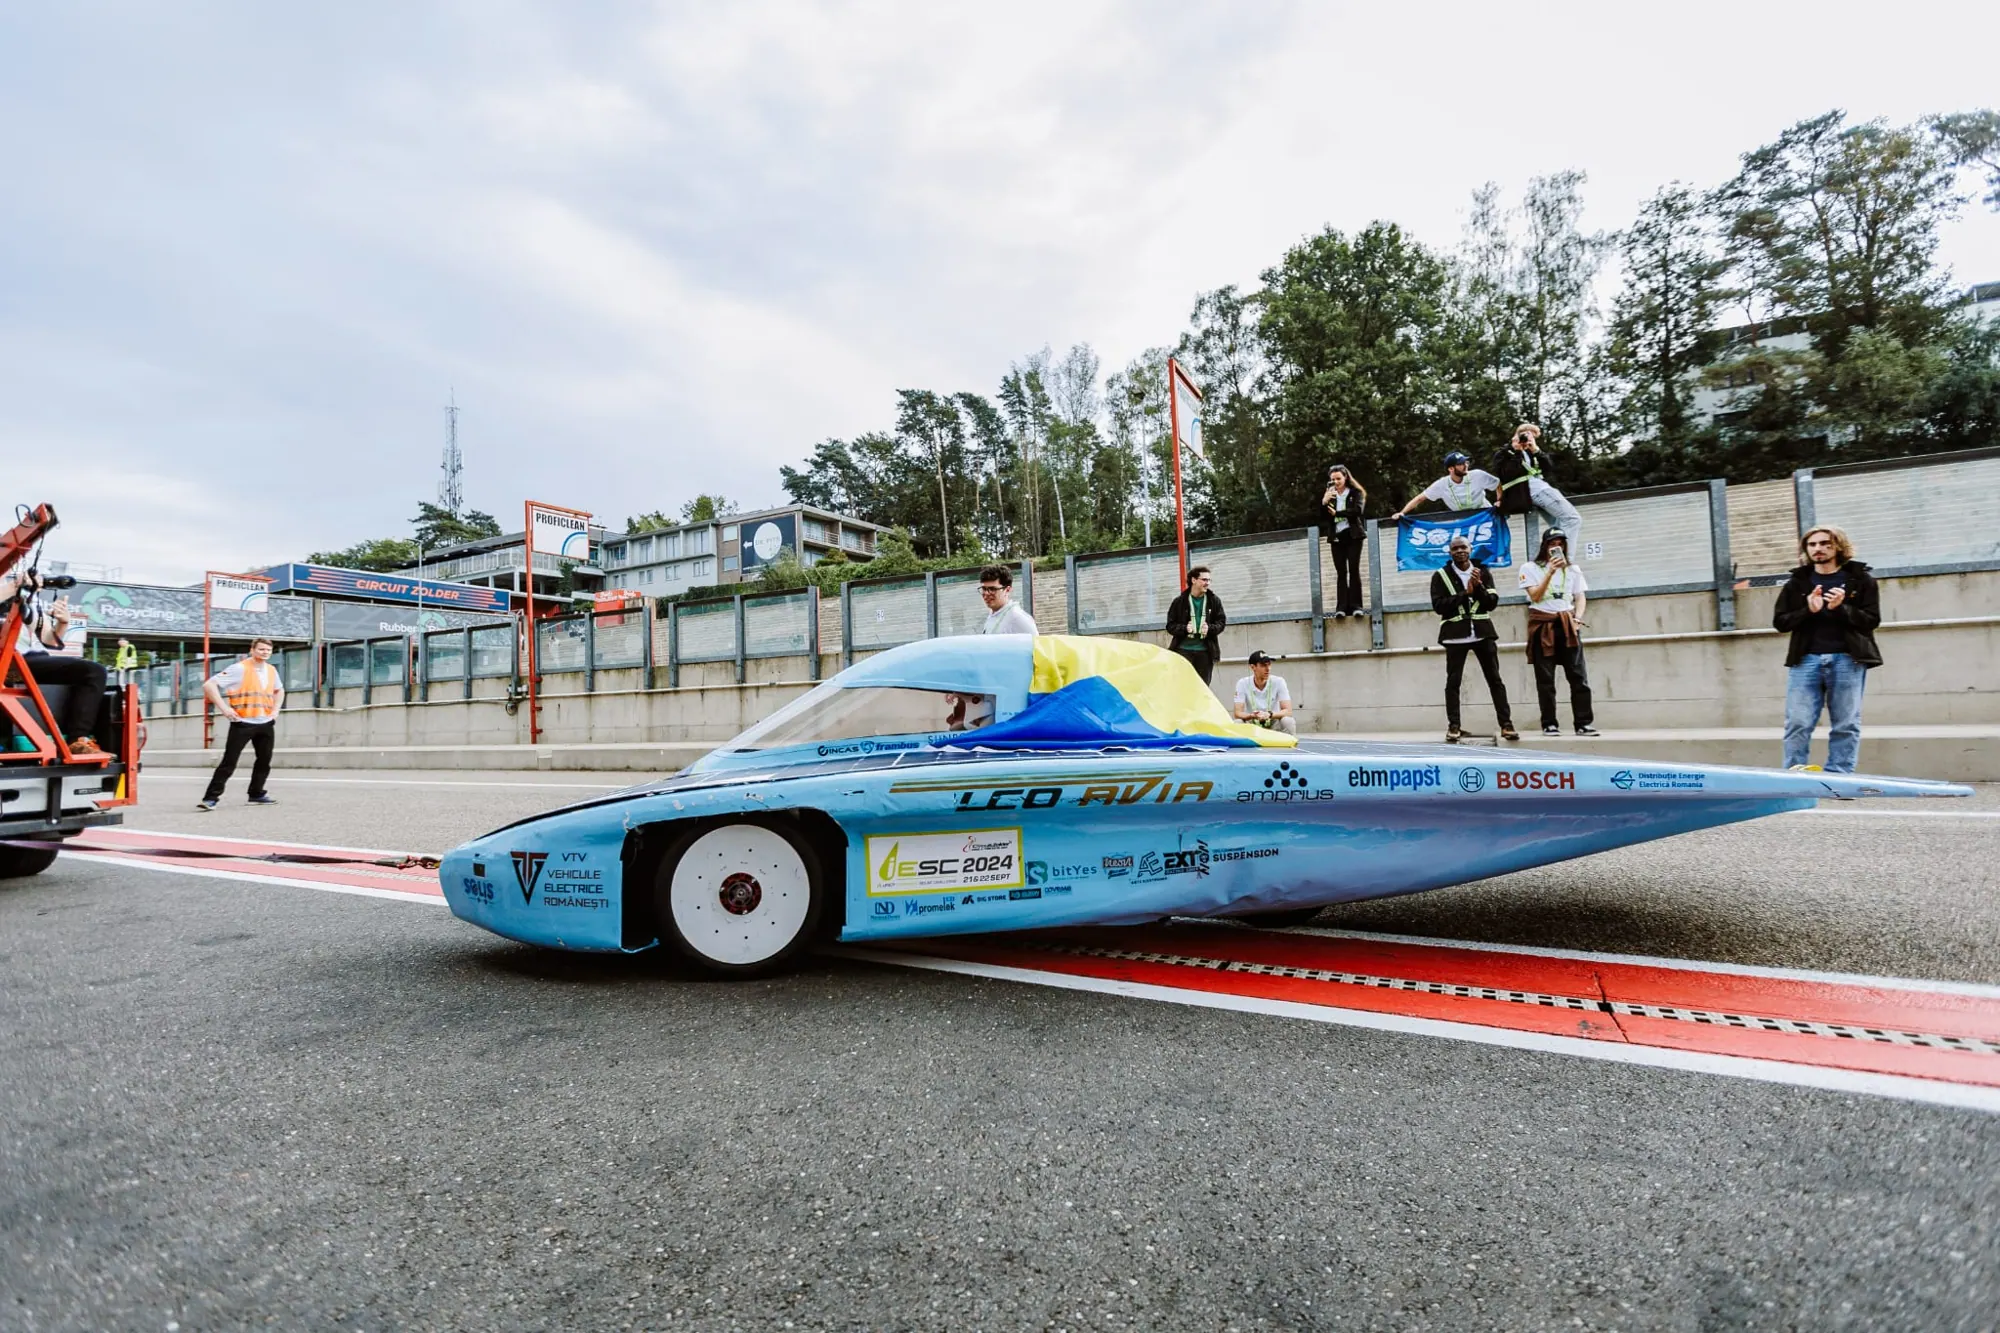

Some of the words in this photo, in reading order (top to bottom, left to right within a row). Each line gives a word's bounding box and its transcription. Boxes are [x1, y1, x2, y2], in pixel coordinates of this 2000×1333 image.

[536, 512, 585, 531] PROFICLEAN
[1587, 543, 1601, 555] 55
[216, 579, 265, 592] PROFICLEAN
[355, 579, 409, 594] CIRCUIT
[410, 585, 460, 600] ZOLDER
[100, 604, 176, 622] Recycling
[379, 621, 418, 634] Rubber
[875, 741, 920, 751] frambus
[1349, 765, 1441, 791] ebmpapst
[1496, 771, 1575, 790] BOSCH
[1679, 772, 1705, 780] Energie
[1078, 777, 1214, 807] AVIA
[1236, 788, 1334, 802] amprius
[562, 852, 587, 862] VTV
[1163, 851, 1198, 868] EXT
[1213, 848, 1279, 862] SUSPENSION
[962, 855, 1012, 873] 2024
[547, 869, 601, 880] VEHICULE
[990, 873, 1011, 881] SEPT
[1052, 865, 1098, 877] bitYes
[544, 883, 604, 894] ELECTRICE
[988, 894, 1007, 902] STORE
[919, 897, 956, 915] promelek
